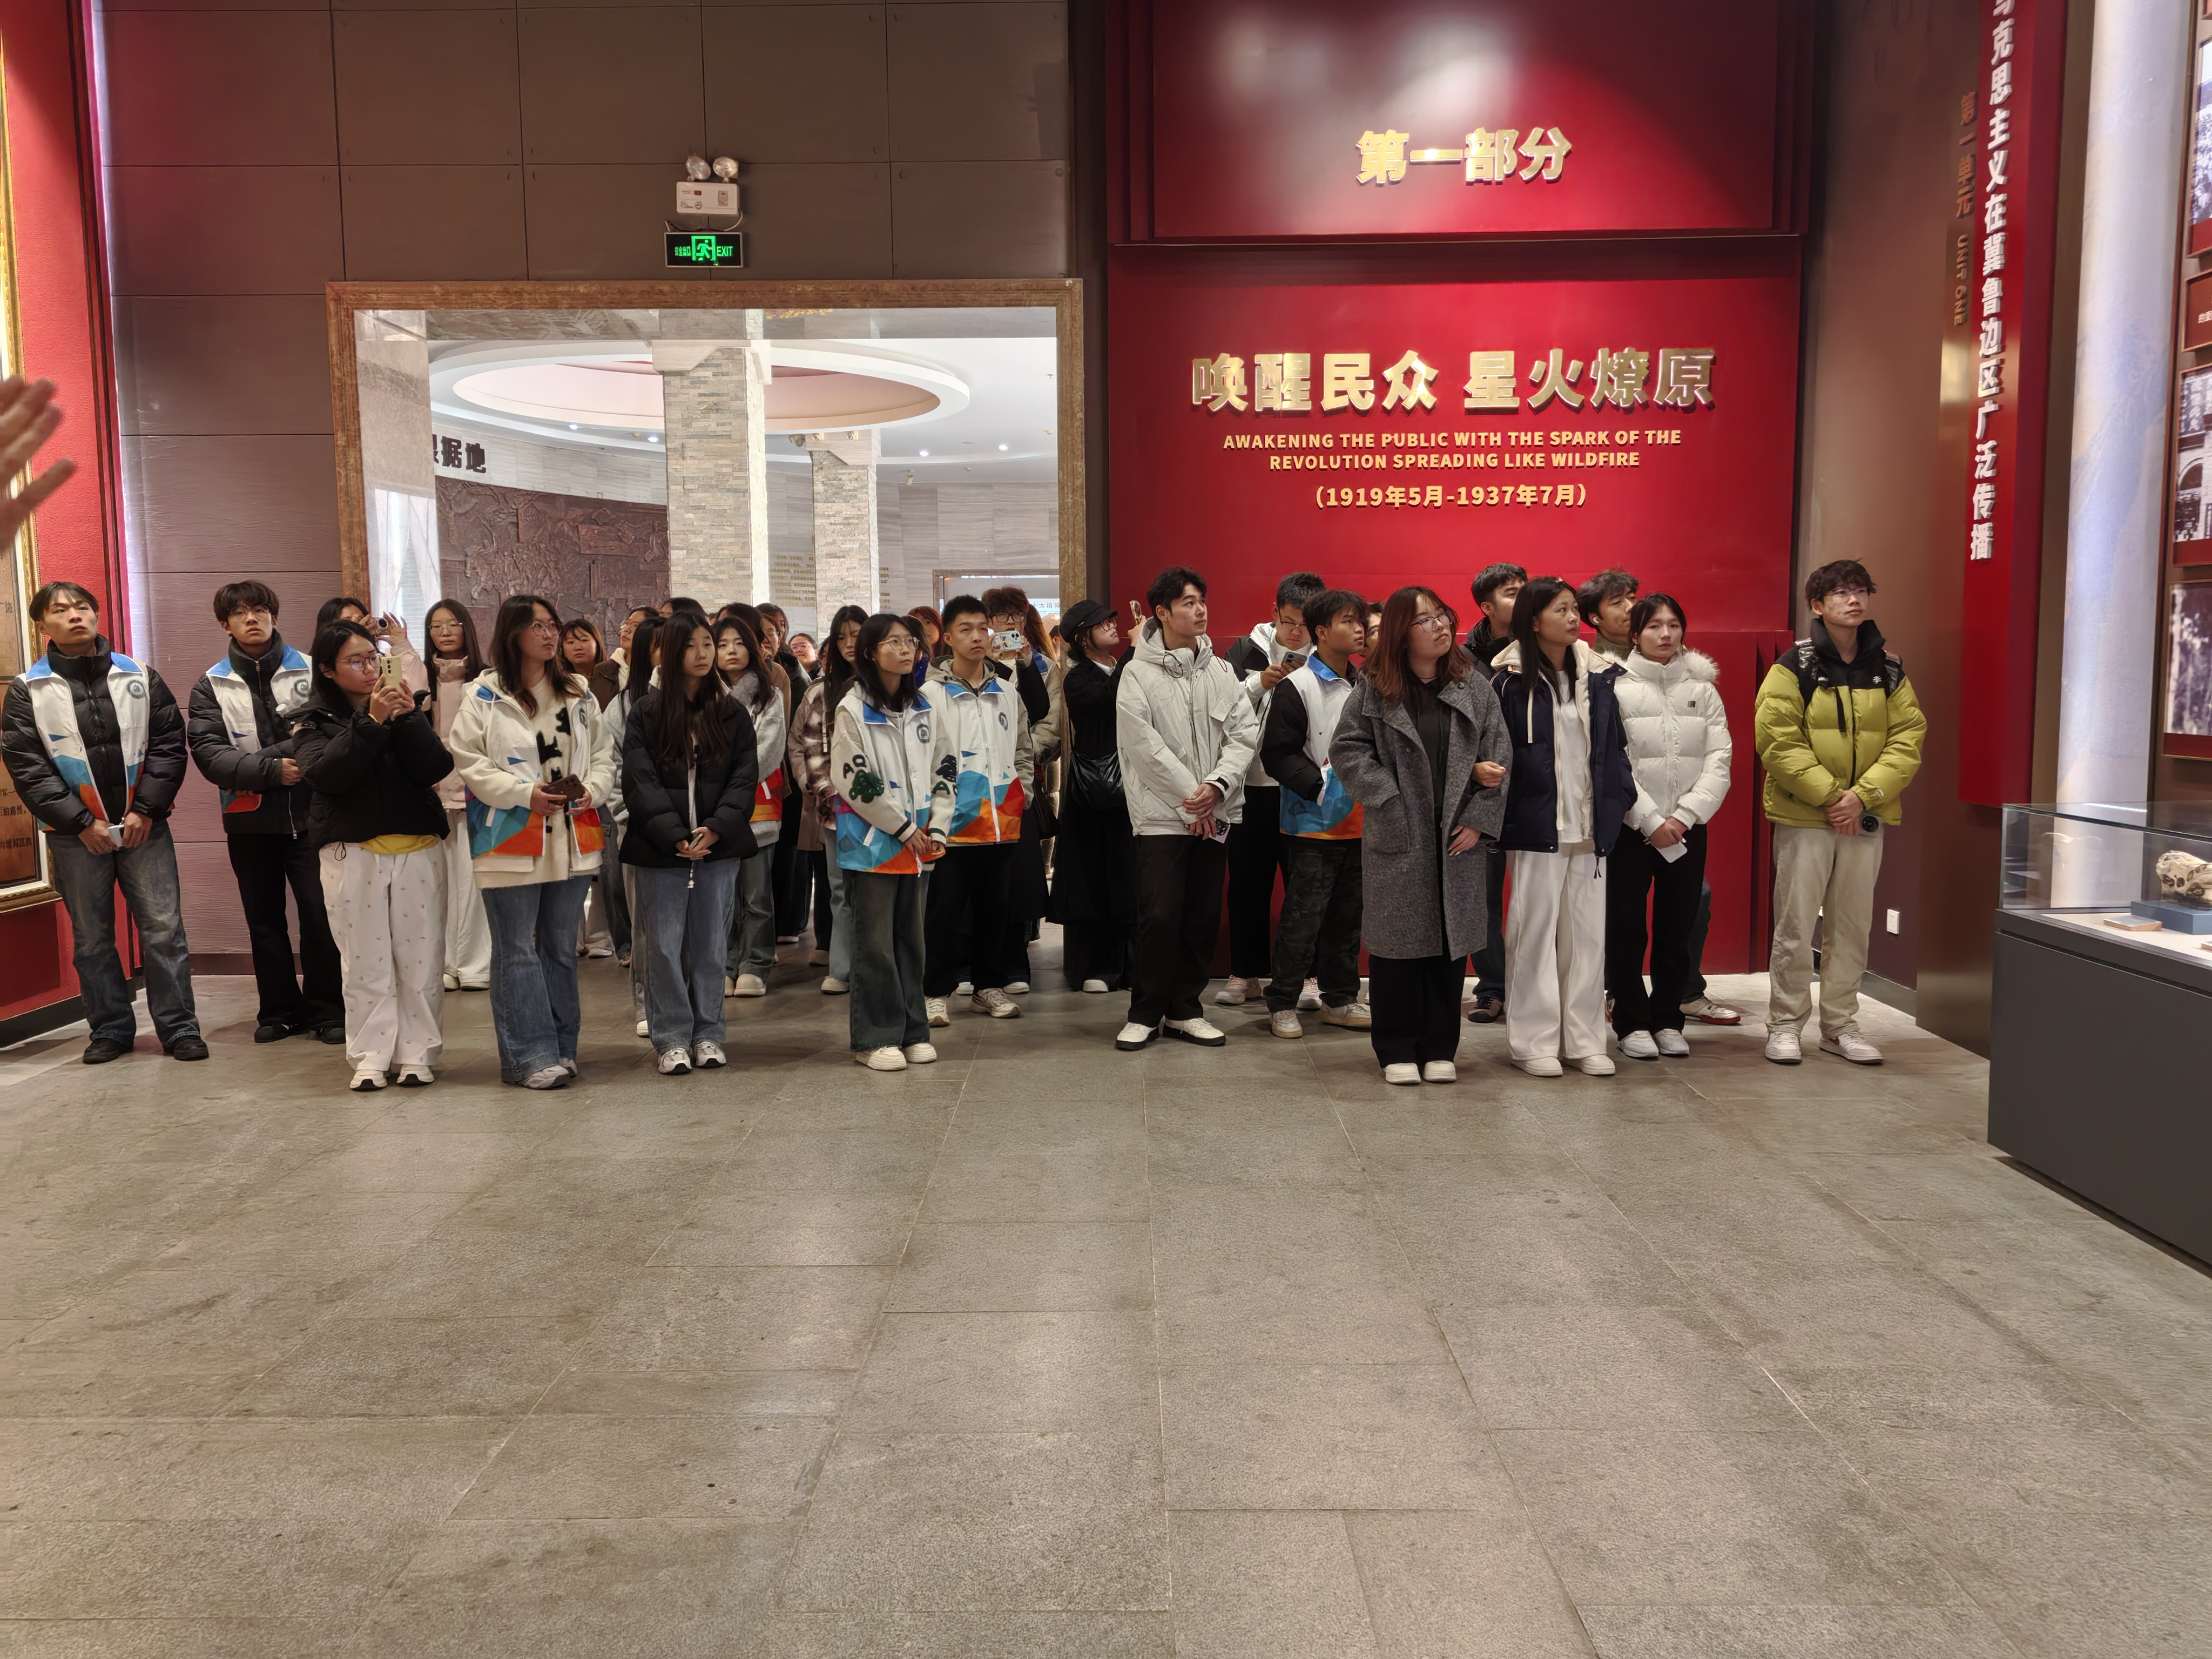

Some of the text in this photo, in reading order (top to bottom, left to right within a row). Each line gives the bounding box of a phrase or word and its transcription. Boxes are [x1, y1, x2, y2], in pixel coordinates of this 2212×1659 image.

[1356, 127, 1572, 185] 第一部分
[1956, 91, 1977, 219] 第一单元
[717, 246, 733, 257] EXIT
[1954, 233, 1969, 326] UNIT ONE
[1192, 347, 1715, 413] 唤醒民众 星火燎原
[1223, 430, 1681, 449] AWAKENING THE PUBLIC WITH THE SPARK OF THE
[1270, 452, 1640, 469] REVOLUTION SPREADING LIKE WILDFIRE
